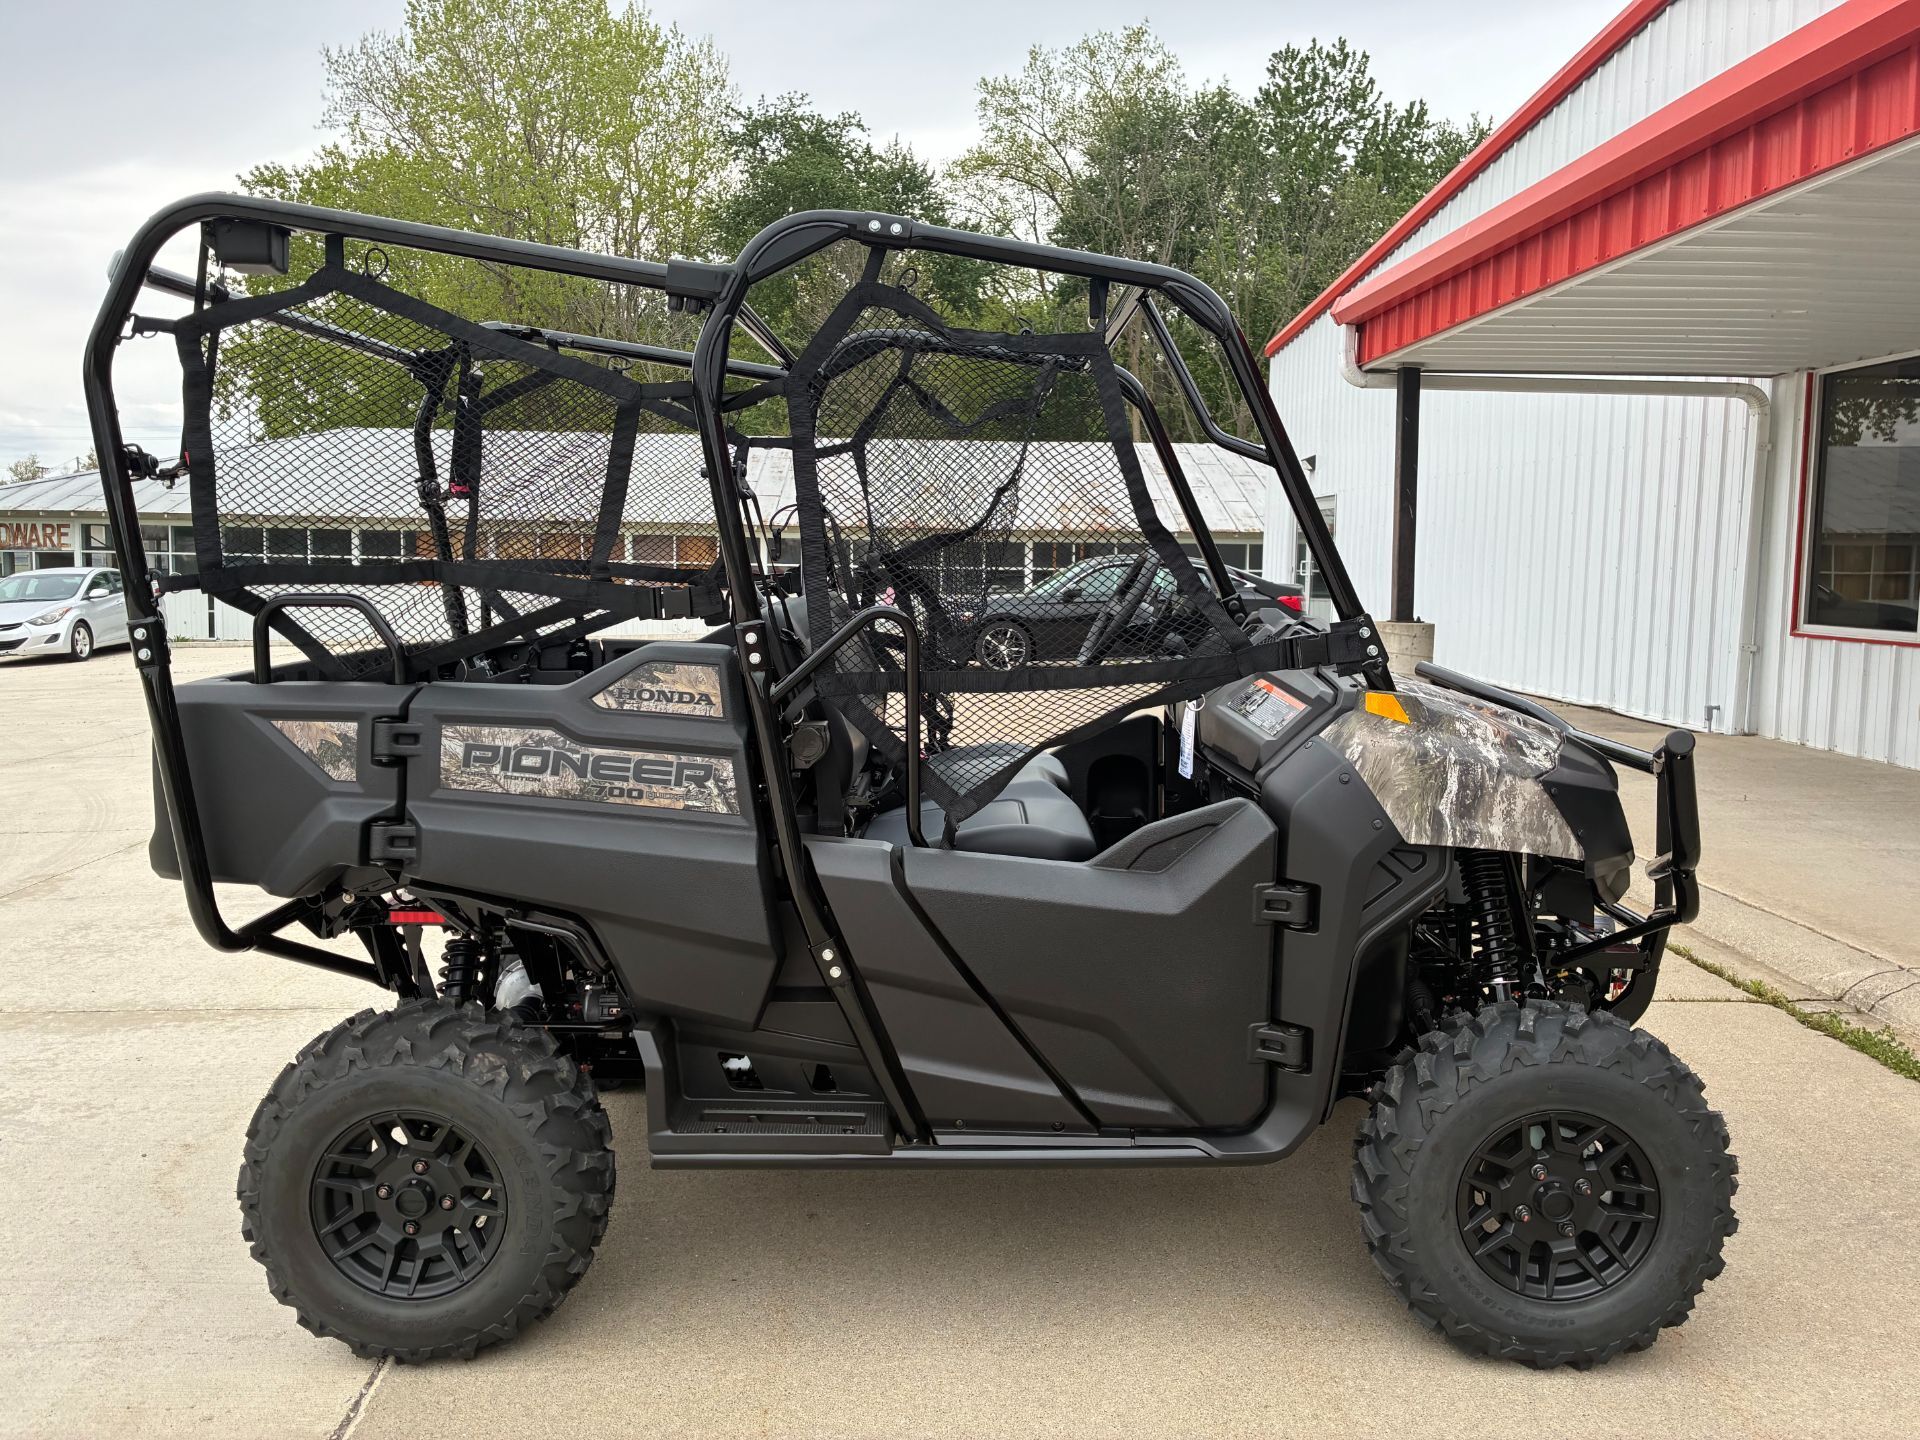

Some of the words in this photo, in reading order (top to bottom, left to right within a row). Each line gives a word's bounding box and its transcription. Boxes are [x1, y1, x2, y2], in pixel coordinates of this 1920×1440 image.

[0, 523, 71, 548] DWARE
[615, 688, 715, 705] HONDA
[461, 742, 716, 788] PIONEER
[504, 774, 541, 783] EDITION
[590, 785, 645, 800] 700
